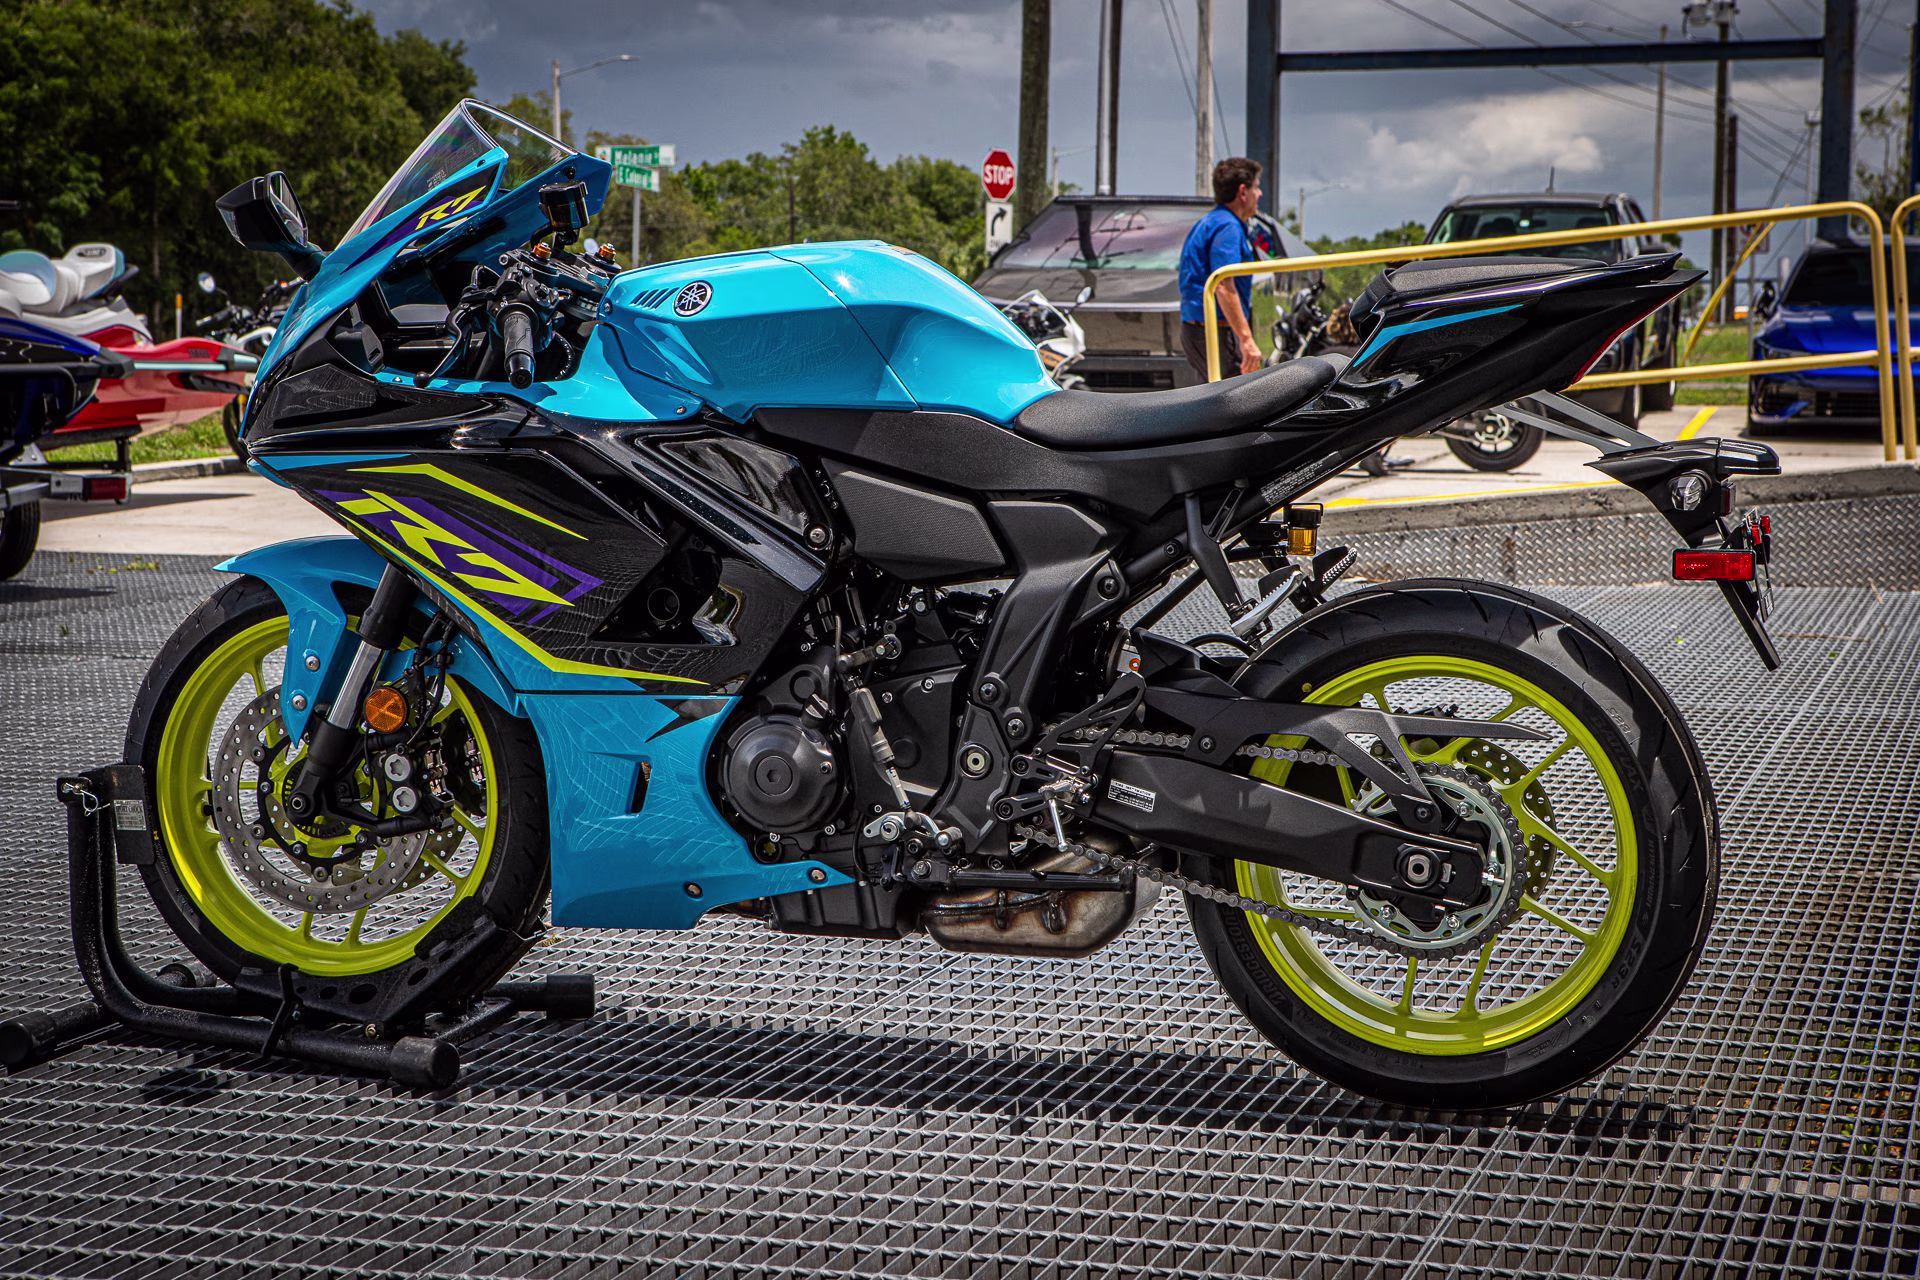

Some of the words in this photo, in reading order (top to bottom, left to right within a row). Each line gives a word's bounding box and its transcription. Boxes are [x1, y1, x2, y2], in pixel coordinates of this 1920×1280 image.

[984, 164, 1014, 185] STOP
[415, 185, 486, 230] R7
[336, 488, 574, 607] R7
